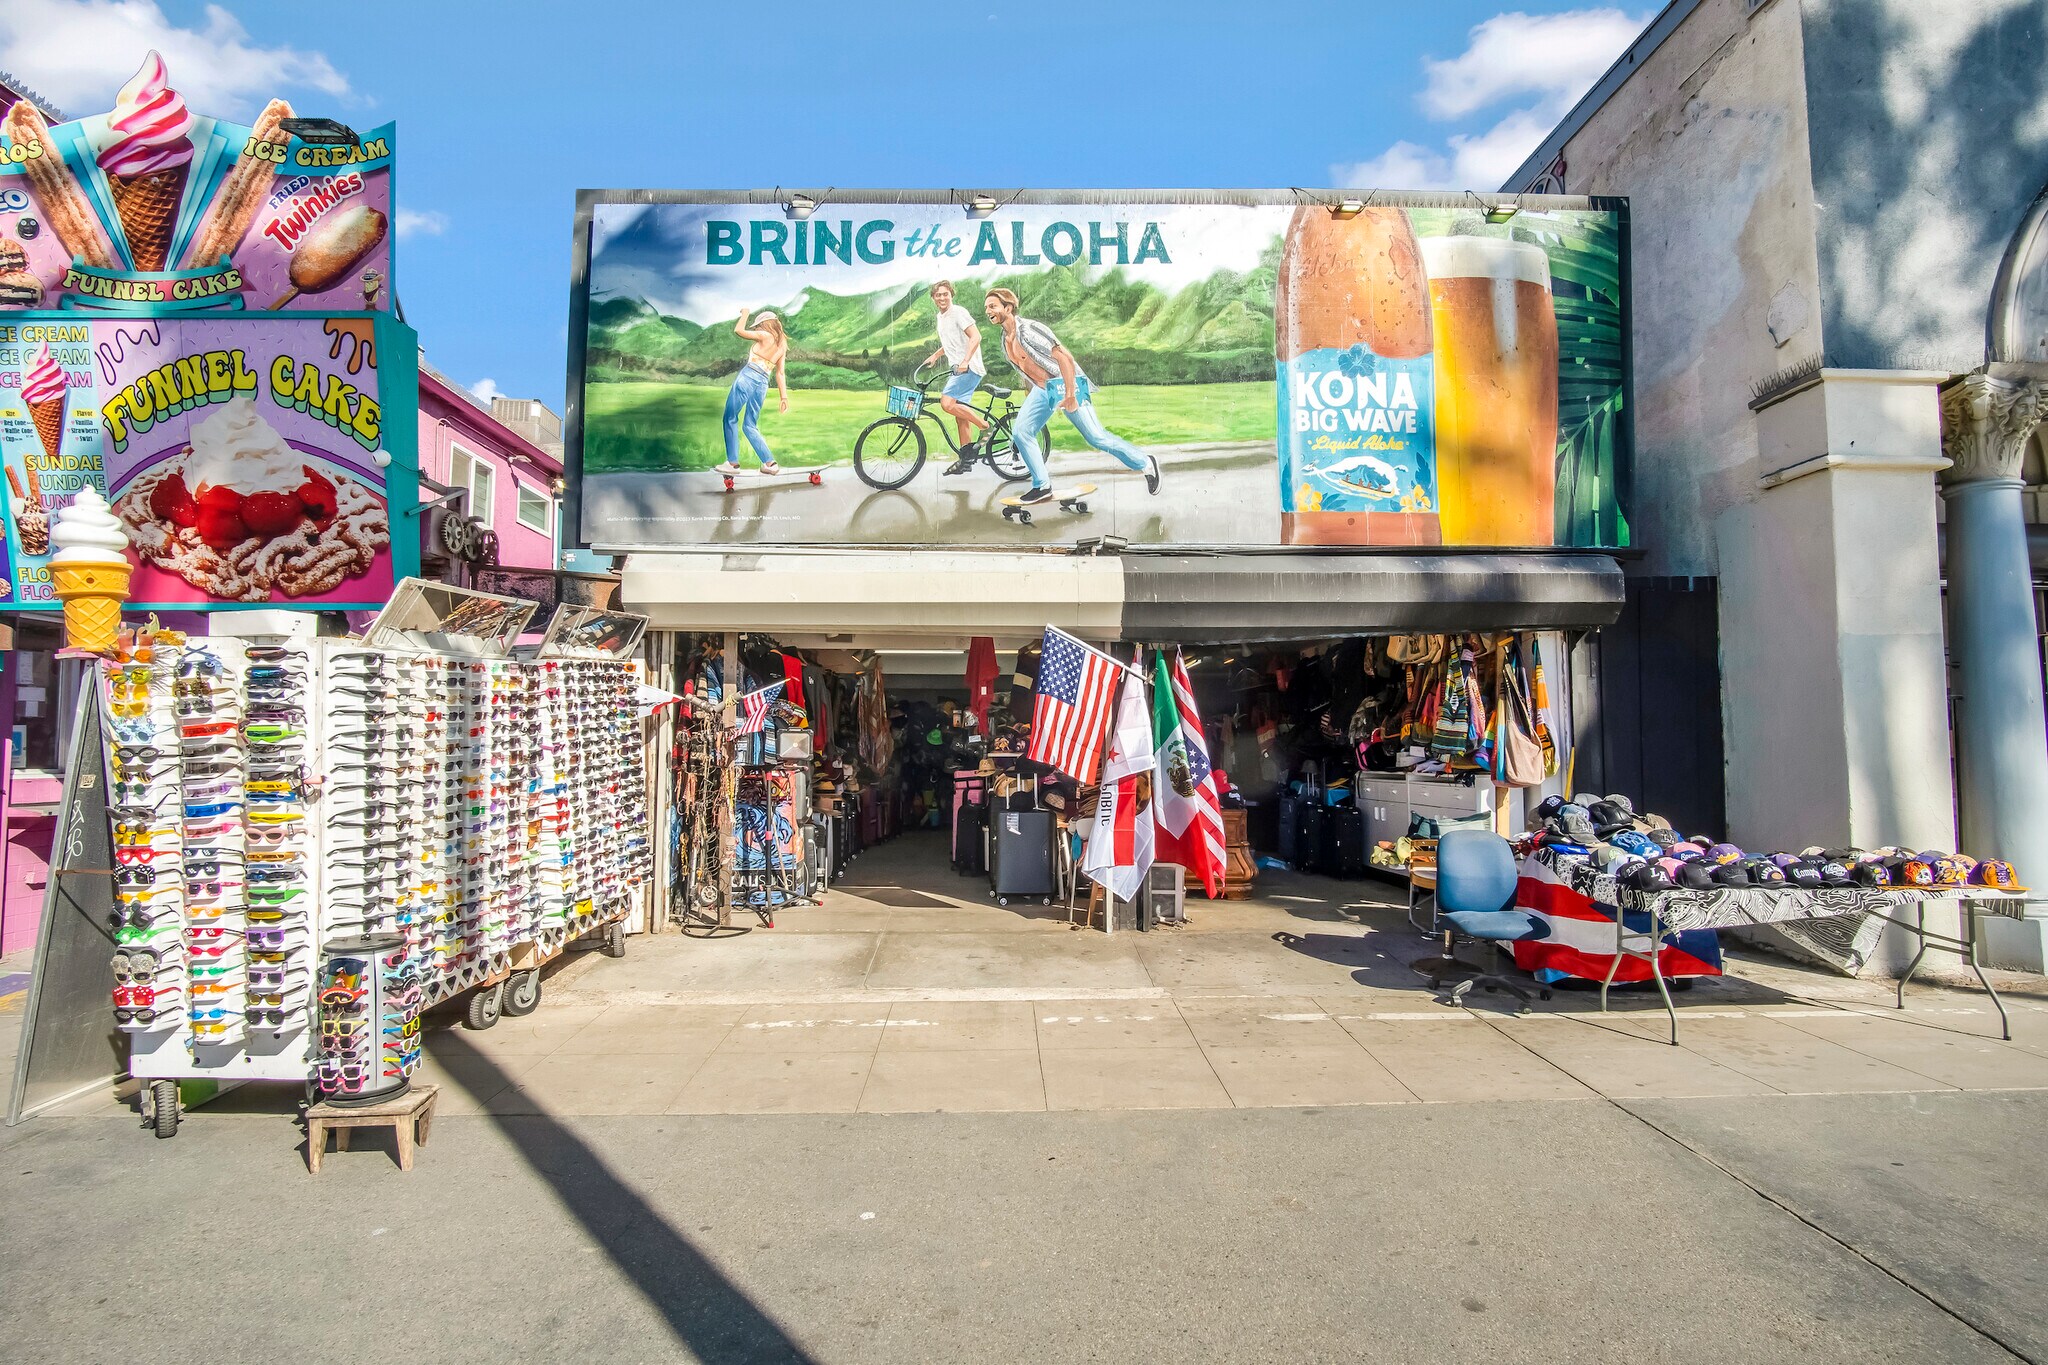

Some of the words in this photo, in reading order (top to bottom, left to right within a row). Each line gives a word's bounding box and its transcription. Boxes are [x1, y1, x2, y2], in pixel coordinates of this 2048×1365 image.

[243, 137, 288, 164] ICE
[295, 138, 390, 167] CREAM
[268, 174, 310, 211] FRIED
[263, 173, 363, 252] Twinkies
[705, 220, 895, 266] BRING
[903, 223, 962, 258] the
[966, 221, 1172, 266] ALOHA
[62, 269, 165, 301] FUNNEL
[172, 269, 243, 300] CAKE
[22, 326, 89, 342] CREAM
[102, 349, 258, 447] FUNNEL
[270, 354, 382, 446] CAKE
[1295, 370, 1419, 410] KONA
[1296, 409, 1339, 432] BIG
[1342, 408, 1417, 434] WAVE
[1311, 434, 1363, 455] Liquid
[1362, 434, 1404, 451] Aloha
[25, 455, 104, 471] SUNDAE
[39, 475, 106, 491] UNDAE
[1650, 867, 1668, 881] LA
